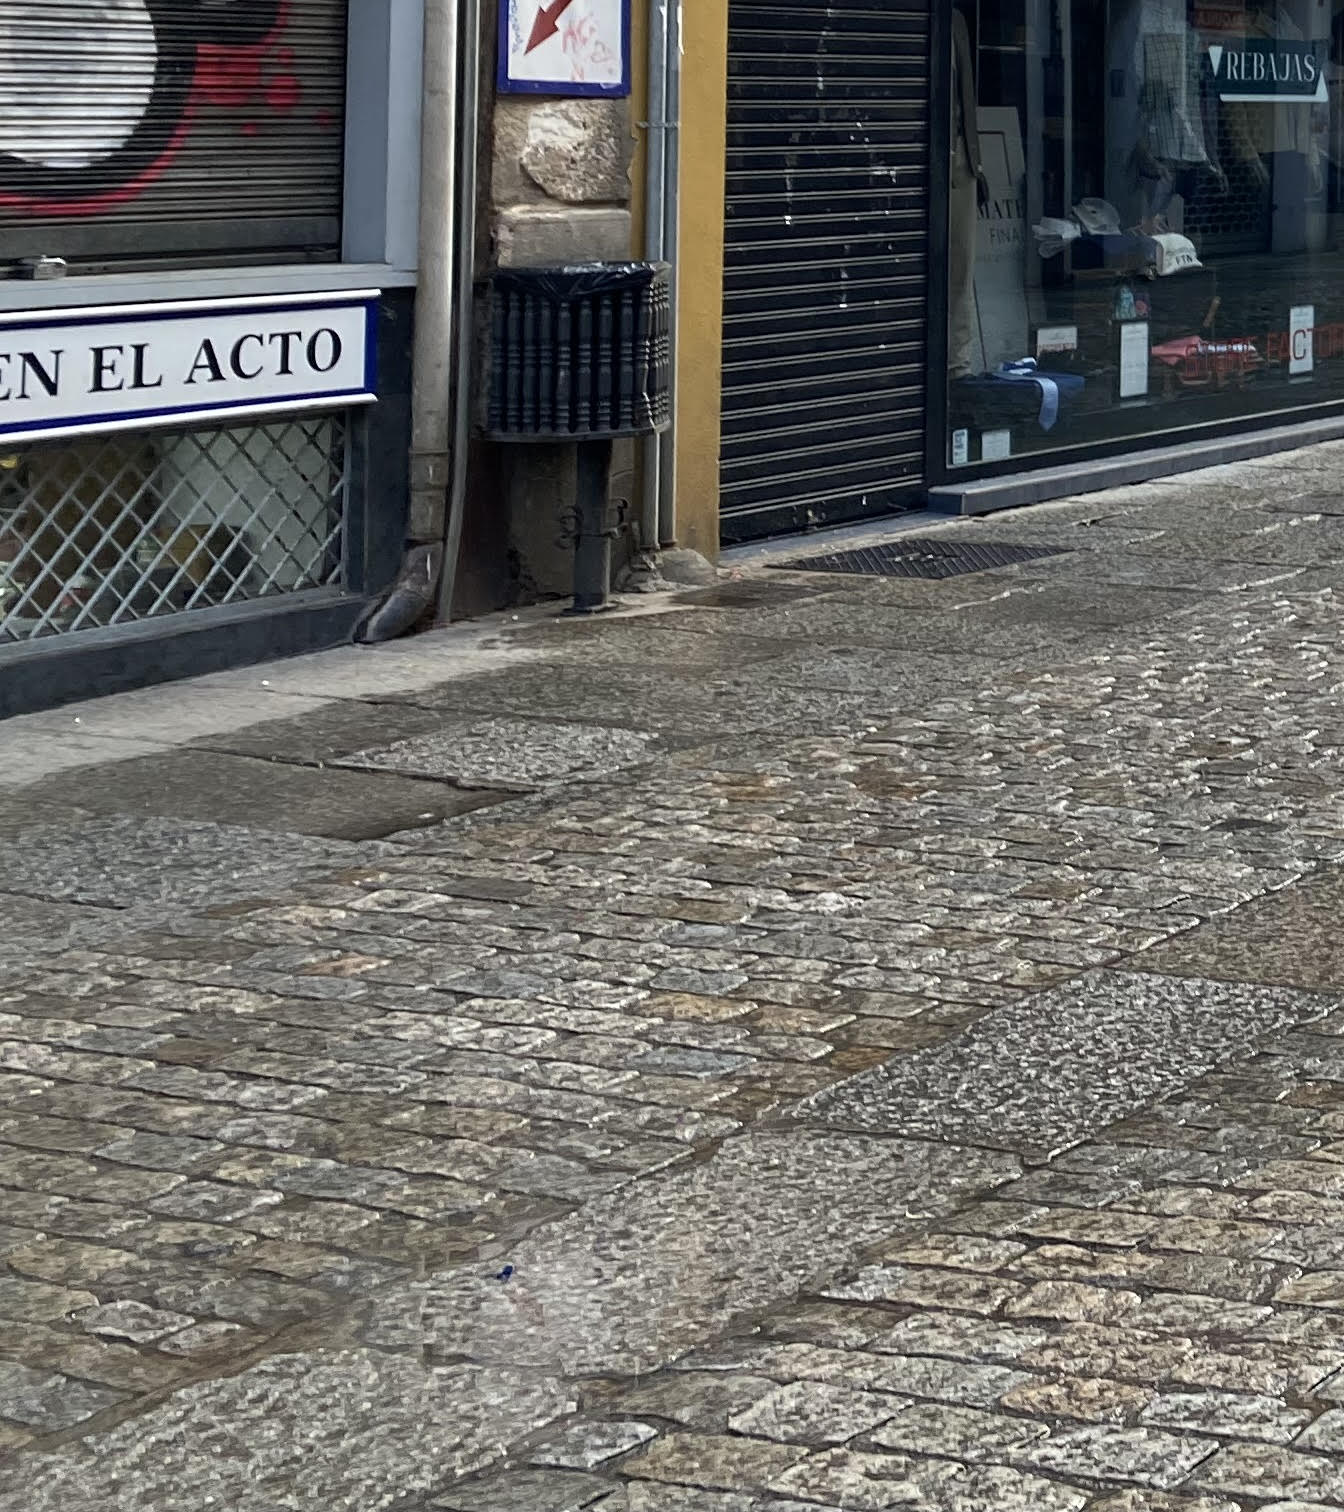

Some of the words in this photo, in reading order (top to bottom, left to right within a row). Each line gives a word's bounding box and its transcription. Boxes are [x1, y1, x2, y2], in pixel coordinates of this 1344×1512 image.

[1226, 50, 1316, 83] REBAJAS
[87, 342, 164, 394] EL
[183, 326, 342, 385] ACTO
